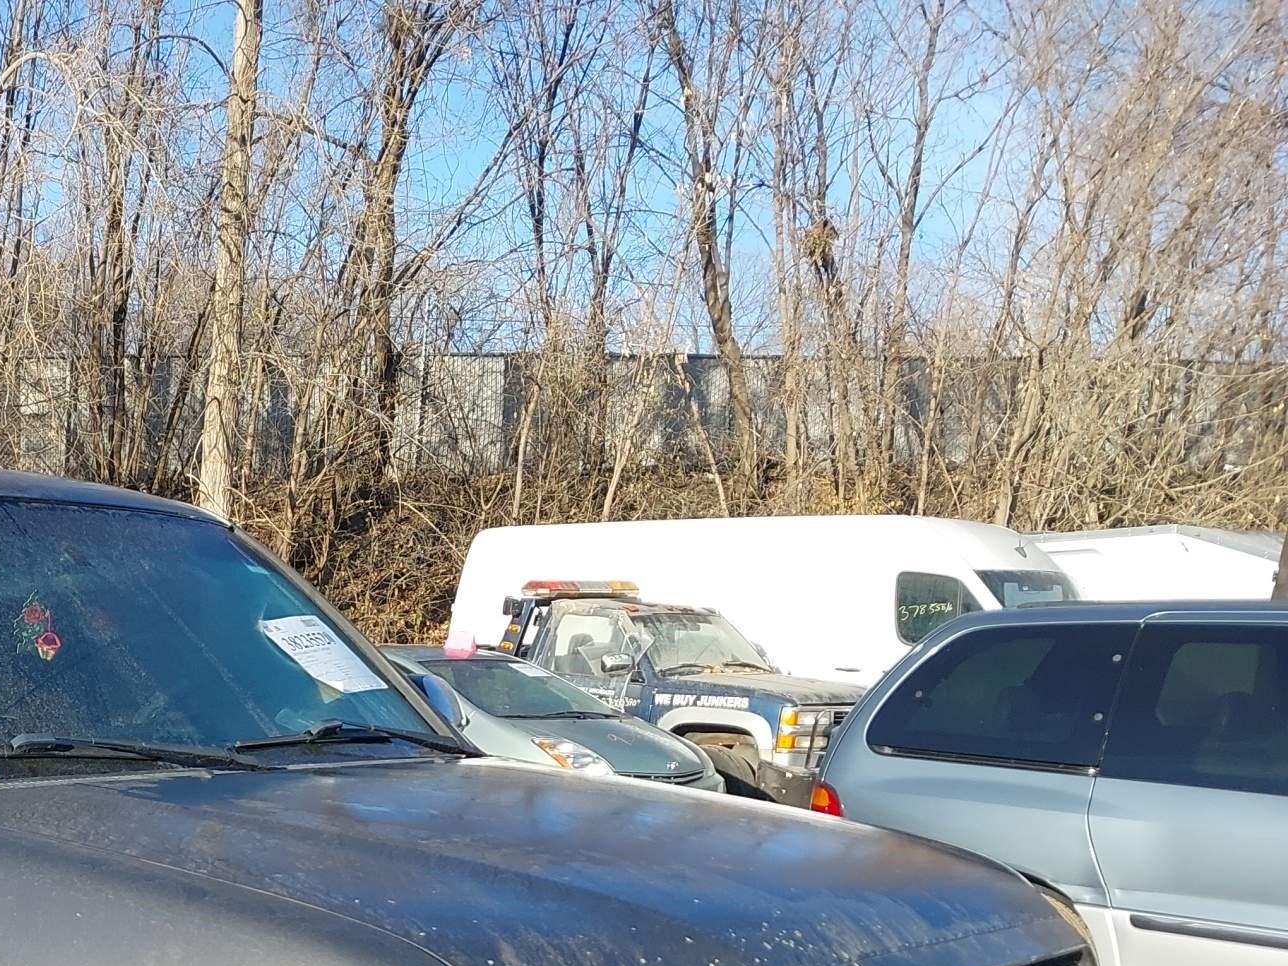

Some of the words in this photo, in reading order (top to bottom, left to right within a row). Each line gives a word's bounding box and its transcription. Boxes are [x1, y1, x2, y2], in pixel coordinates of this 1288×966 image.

[655, 693, 672, 706] WE
[672, 694, 696, 707] BUY
[696, 695, 749, 709] JUNKERS
